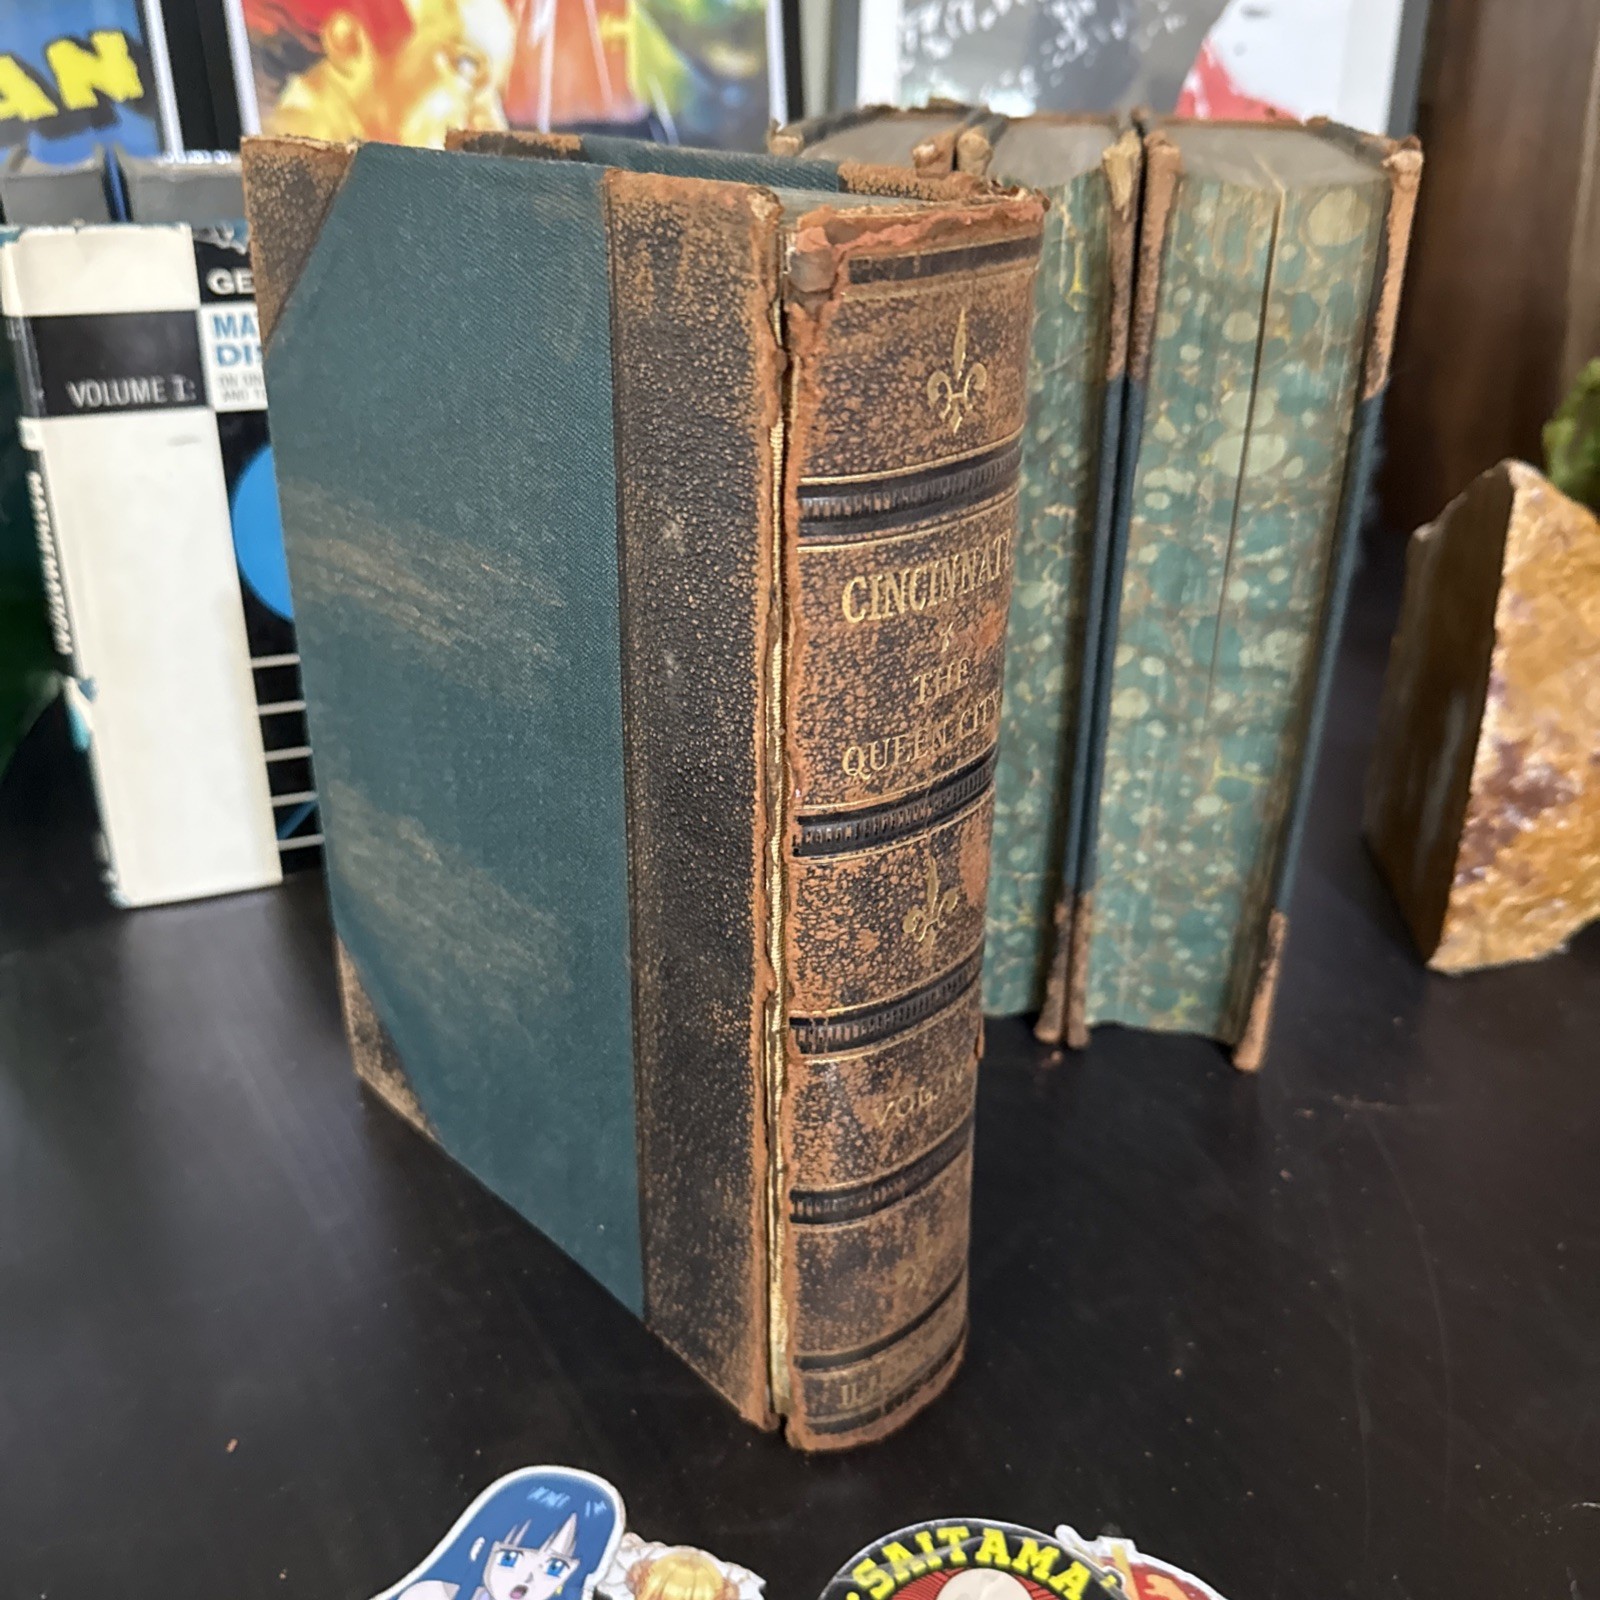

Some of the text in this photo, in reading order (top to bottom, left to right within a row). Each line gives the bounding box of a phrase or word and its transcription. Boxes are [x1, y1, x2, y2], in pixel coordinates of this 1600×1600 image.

[206, 267, 255, 295] GE
[66, 377, 167, 409] VOLUME
[913, 657, 971, 704] THE
[841, 719, 952, 780] QUEEN
[852, 1525, 1092, 1600] SAITAMA
